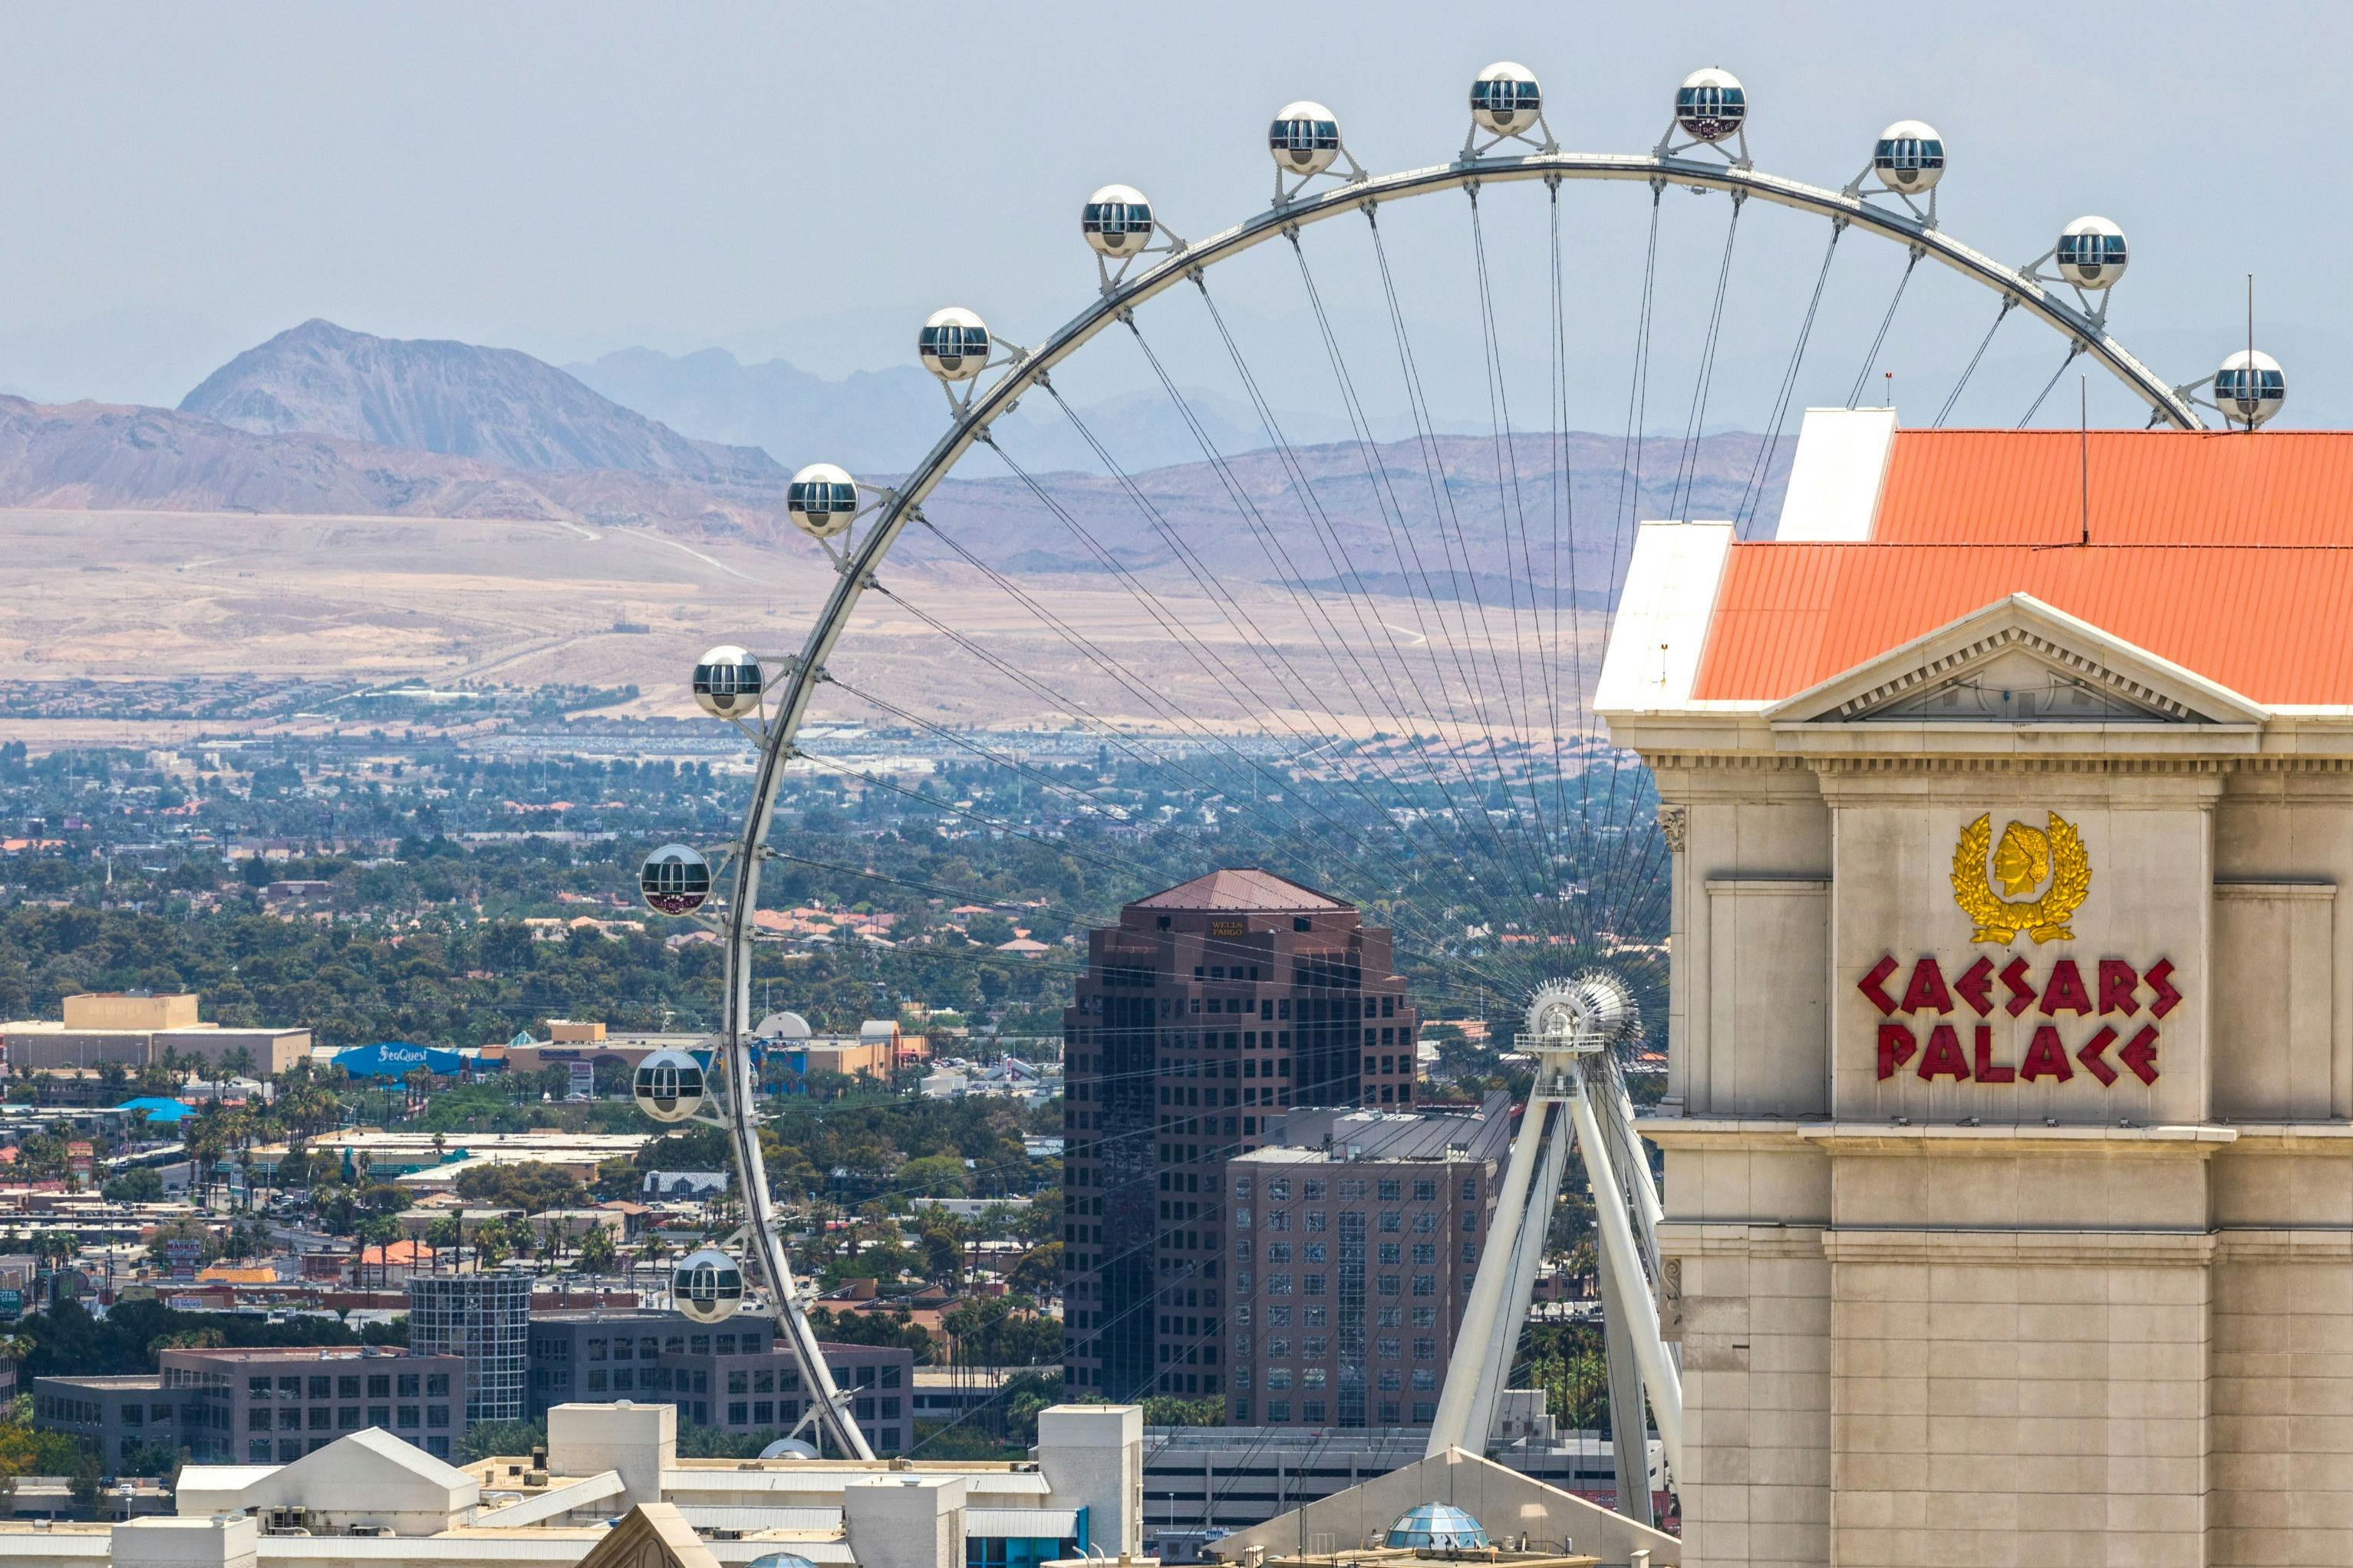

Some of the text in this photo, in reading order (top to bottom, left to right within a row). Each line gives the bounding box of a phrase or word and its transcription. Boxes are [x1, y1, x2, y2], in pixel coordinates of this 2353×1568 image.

[1702, 121, 1735, 133] ROLLER
[1857, 954, 2183, 1020] CAESARS
[377, 1045, 428, 1062] SeaQuest
[1877, 1024, 2160, 1088] PALACE
